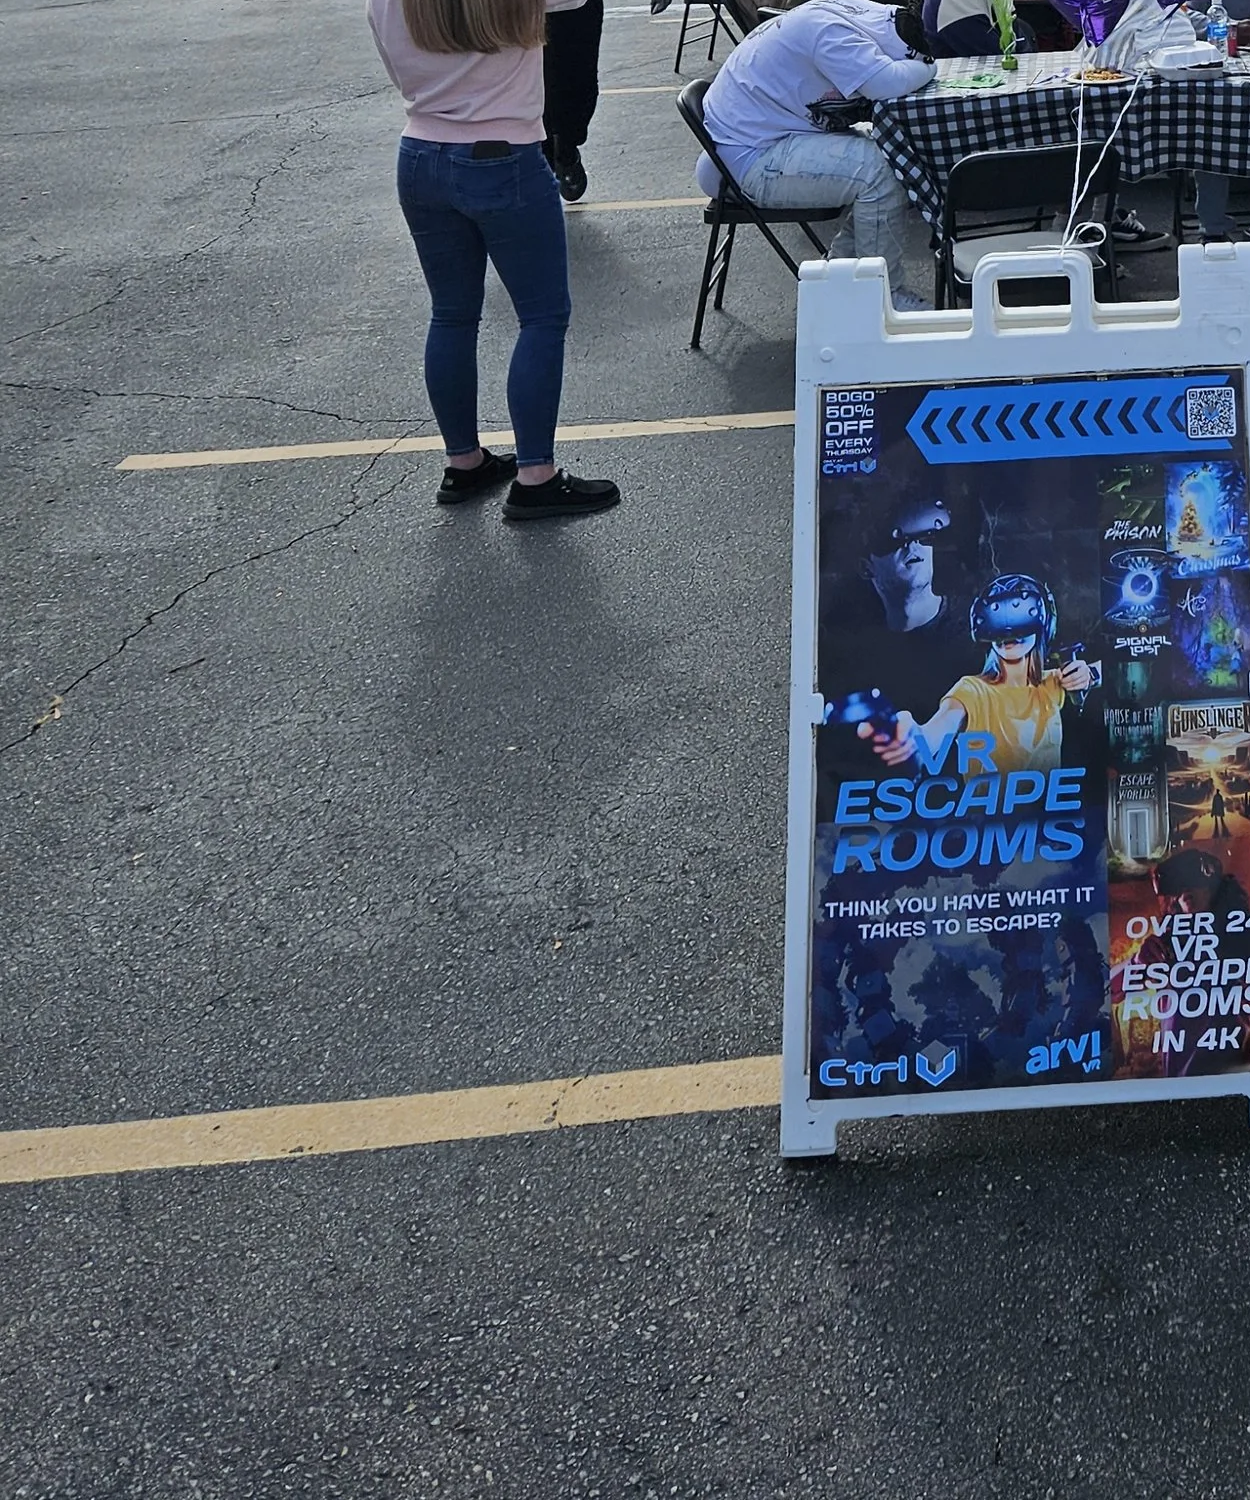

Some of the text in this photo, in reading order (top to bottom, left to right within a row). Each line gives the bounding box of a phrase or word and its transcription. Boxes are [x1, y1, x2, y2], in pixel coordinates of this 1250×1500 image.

[826, 391, 875, 403] BOGO
[826, 404, 874, 418] 50%
[825, 419, 874, 436] OFF
[825, 437, 873, 449] EVERY
[825, 448, 873, 457] THURSDAY
[1104, 525, 1162, 540] PRISON
[1113, 520, 1131, 530] THE
[1114, 635, 1172, 649] SIGNAL
[1130, 645, 1160, 657] LOST
[1103, 708, 1130, 726] HOUSE
[913, 731, 999, 776] VR
[1119, 774, 1155, 787] ESCAPE
[834, 766, 1087, 825] ESCAPE
[1118, 788, 1156, 801] WORLDS
[832, 817, 1086, 874] ROOMS
[825, 886, 1095, 918] THINK YOU HAVE WHAT IT
[858, 912, 1062, 940] TAKES TO ESCAPE?
[1126, 912, 1215, 939] OVER
[1171, 934, 1220, 962] VR
[1152, 1026, 1242, 1054] IN 4K
[819, 1055, 908, 1087] Ctrl
